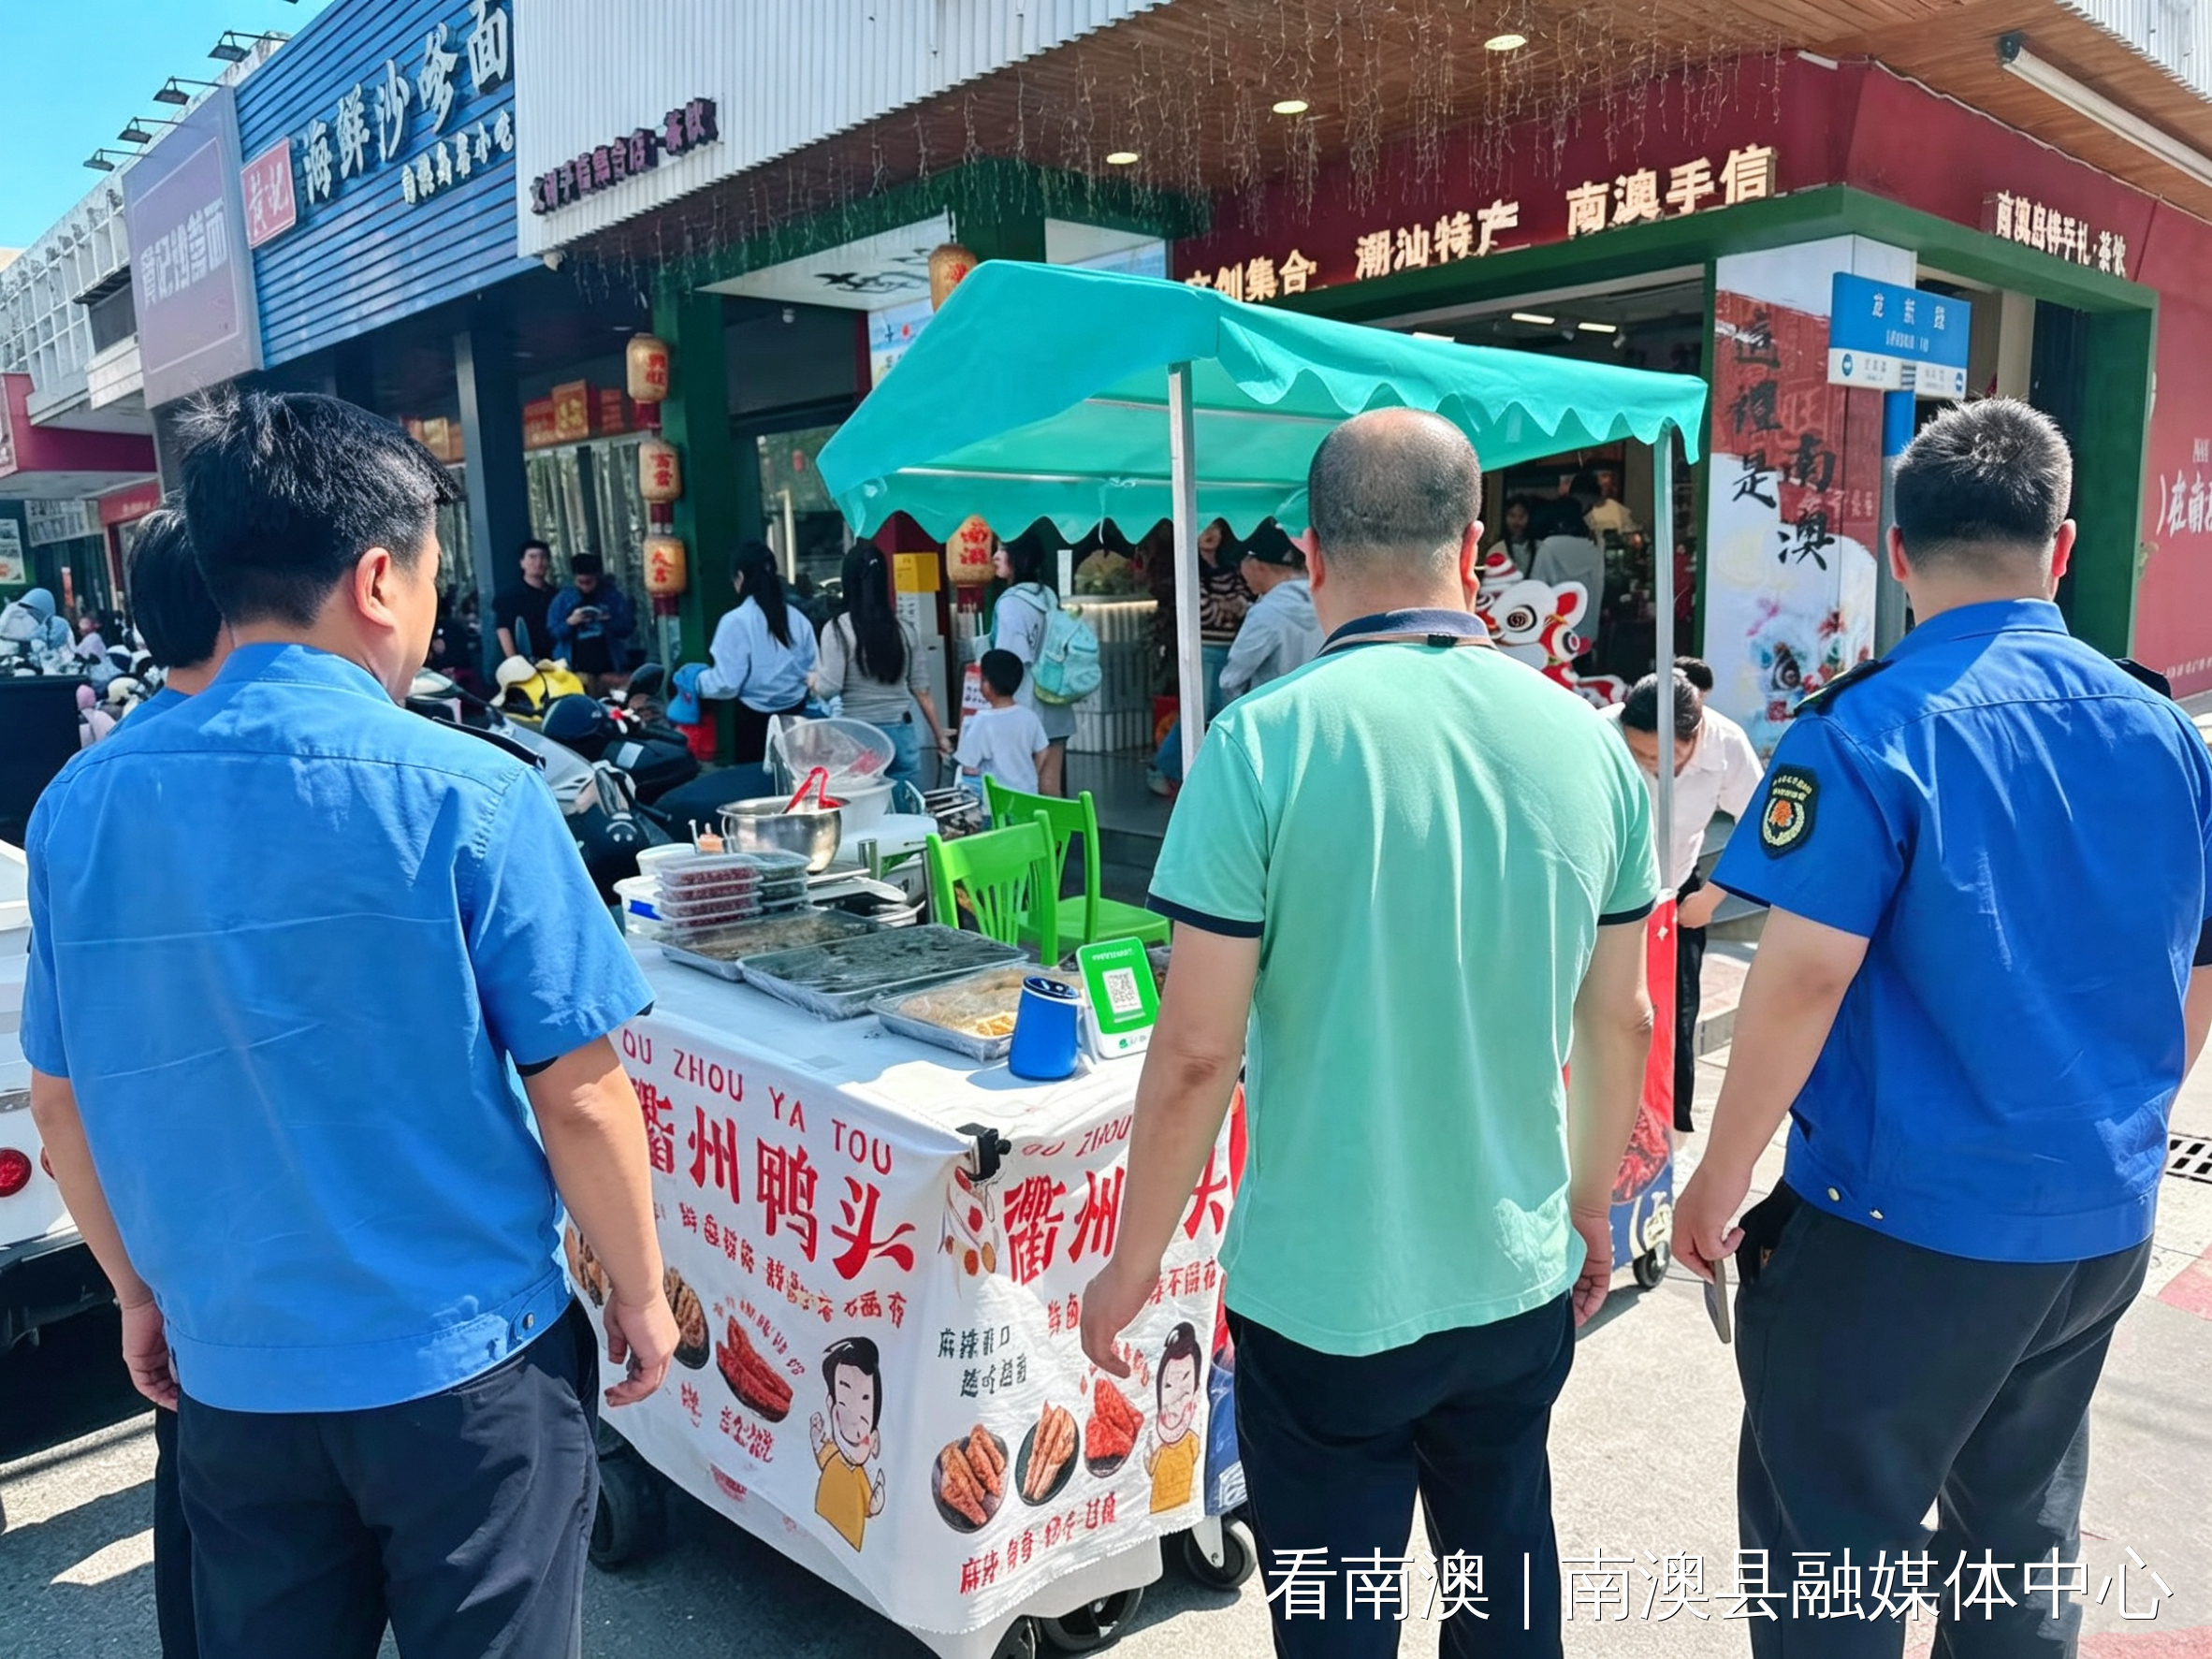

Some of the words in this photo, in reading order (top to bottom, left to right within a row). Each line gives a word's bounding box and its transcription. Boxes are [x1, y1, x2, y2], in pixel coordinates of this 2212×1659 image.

[1355, 199, 1520, 280] 潮汕特产
[1565, 142, 1777, 240] 南澳手信
[1777, 434, 1836, 571] 南澳
[673, 1048, 744, 1102] ZHOU
[768, 1086, 806, 1133] YA
[831, 1118, 892, 1175] TOU
